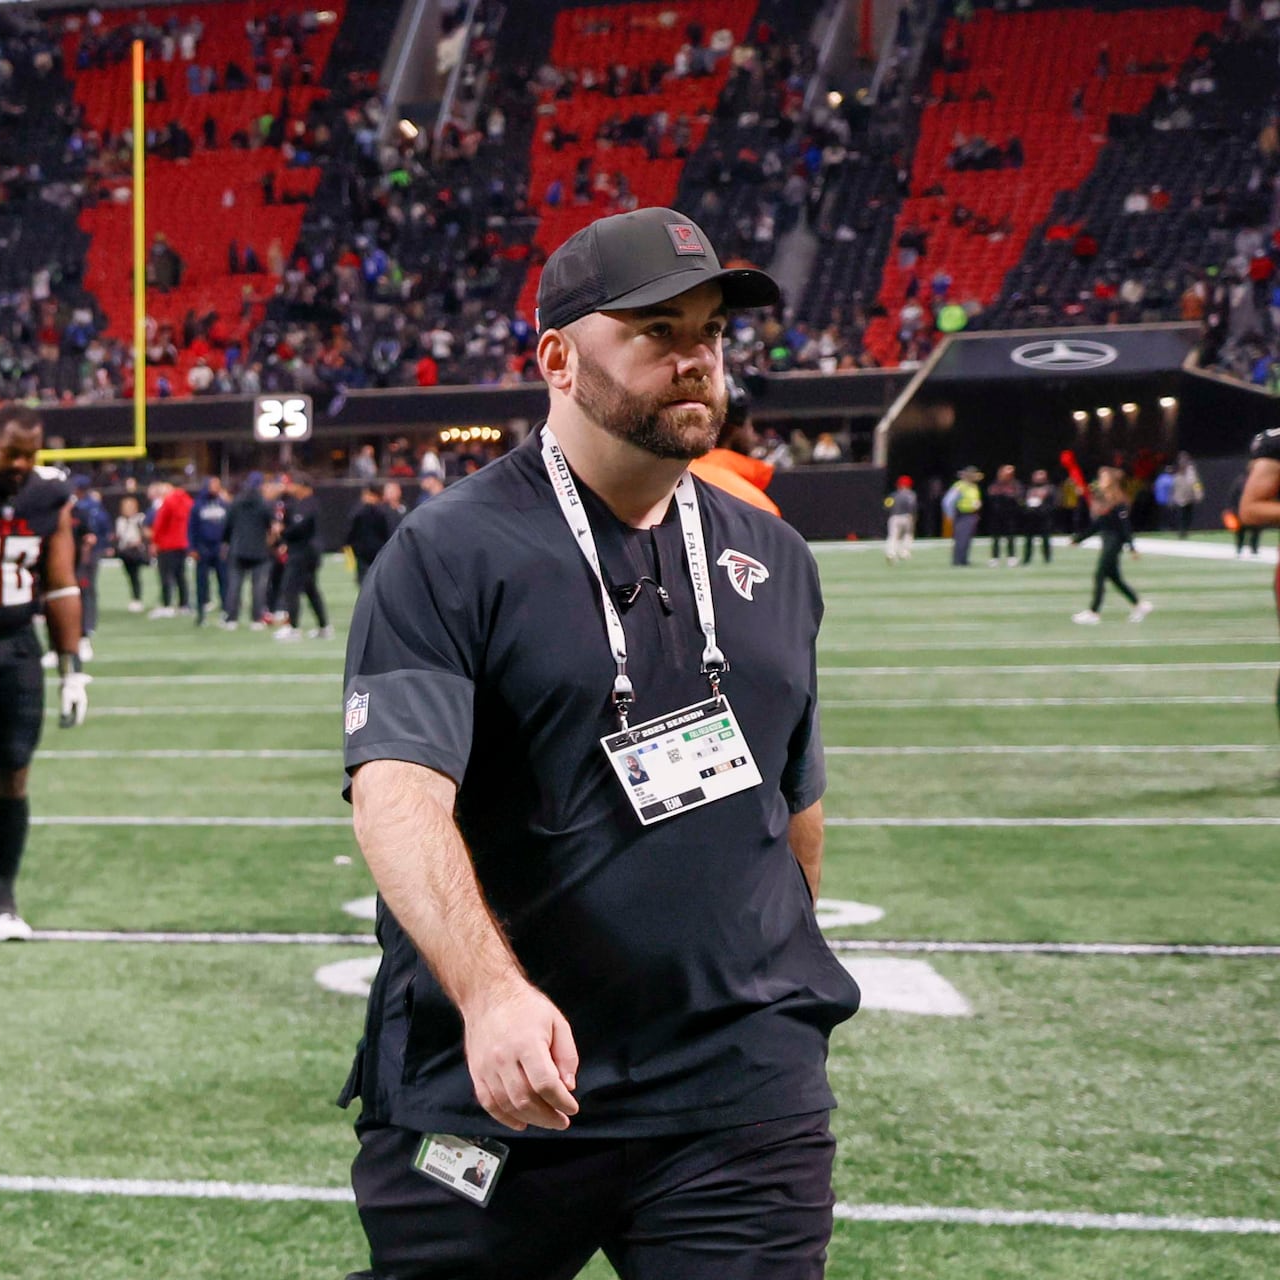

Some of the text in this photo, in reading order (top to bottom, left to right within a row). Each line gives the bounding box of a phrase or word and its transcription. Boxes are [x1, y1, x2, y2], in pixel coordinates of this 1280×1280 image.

[257, 399, 308, 438] 25
[550, 445, 580, 506] FALCONS
[686, 531, 706, 603] FALCONS
[641, 709, 705, 738] 2025 SEASON
[662, 796, 683, 811] TEAM
[431, 1148, 458, 1168] ADM
